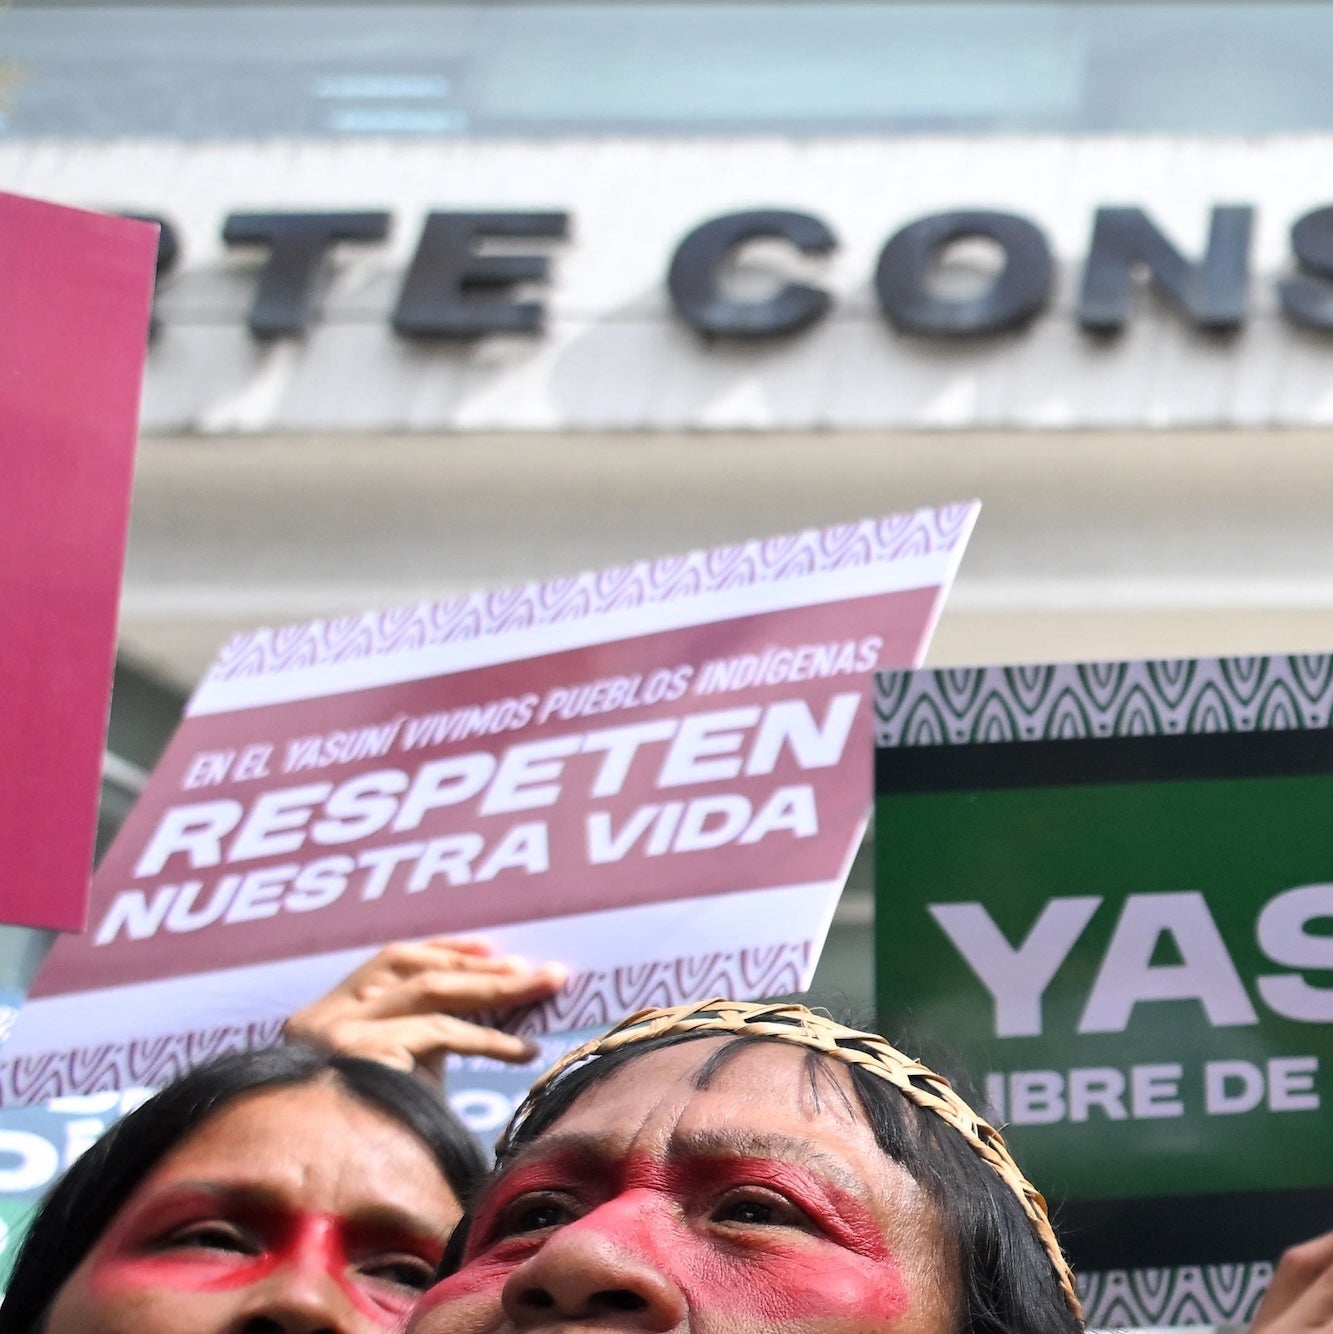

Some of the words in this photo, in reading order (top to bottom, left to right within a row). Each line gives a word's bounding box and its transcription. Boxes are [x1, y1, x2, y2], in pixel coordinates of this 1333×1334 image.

[150, 208, 570, 340] TE
[134, 692, 862, 878] RESPETEN
[183, 750, 235, 790] EN
[231, 744, 274, 783] EL
[282, 714, 408, 774] YASUNÍ
[400, 693, 540, 752] VIVIMOS
[537, 664, 694, 725] PUEBLOS
[694, 636, 883, 696] INDÍGENAS
[94, 821, 549, 946] NUESTRA
[586, 784, 819, 865] VIDA
[984, 1062, 1185, 1126] IBRE
[1203, 1054, 1320, 1115] DE
